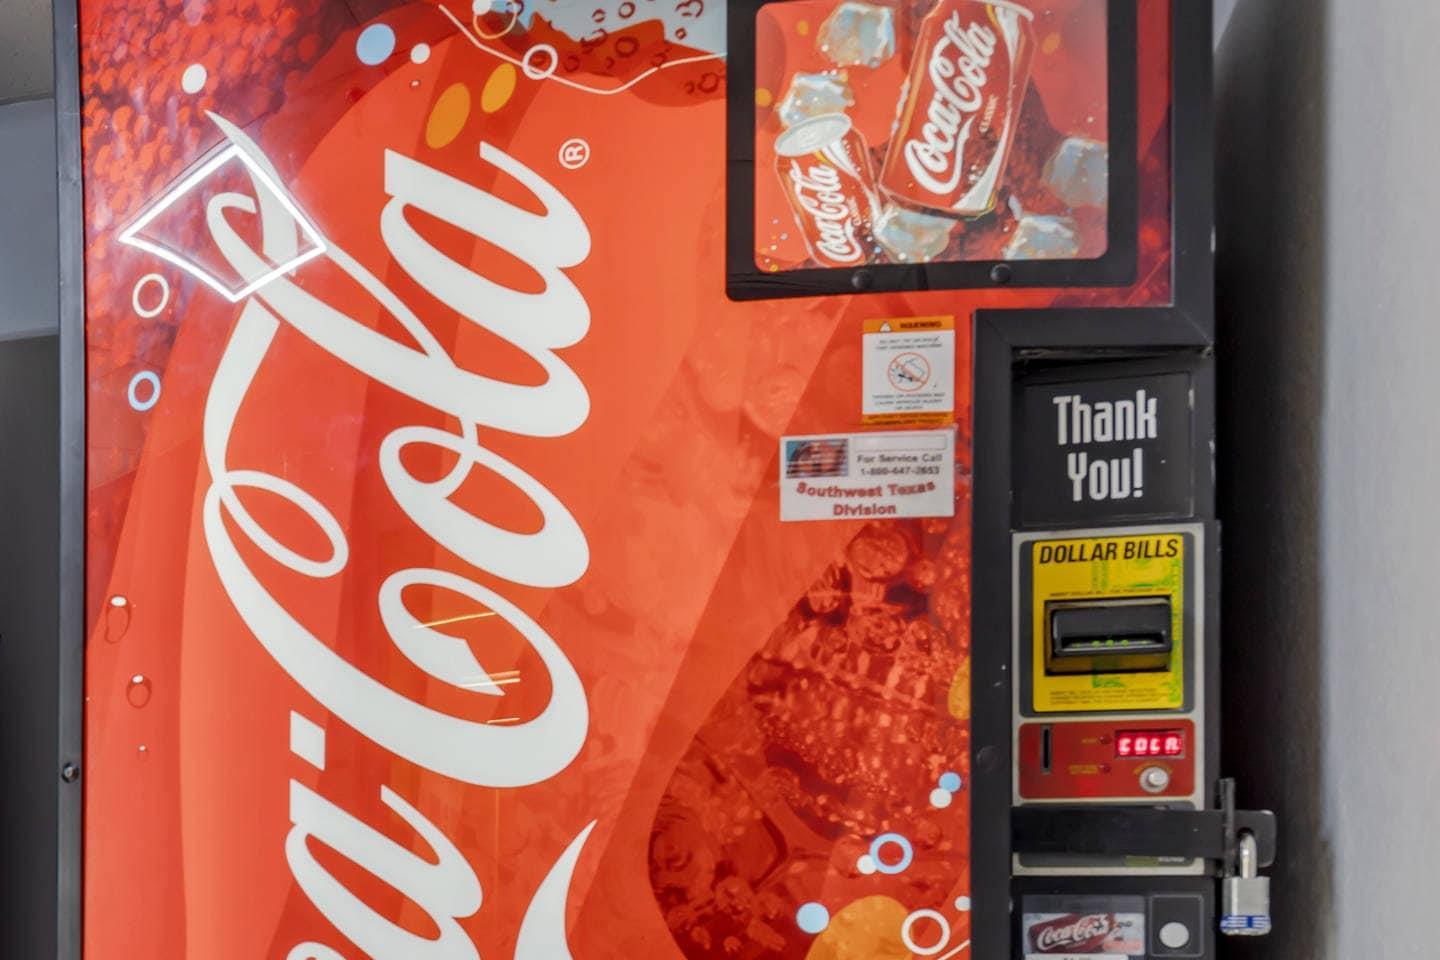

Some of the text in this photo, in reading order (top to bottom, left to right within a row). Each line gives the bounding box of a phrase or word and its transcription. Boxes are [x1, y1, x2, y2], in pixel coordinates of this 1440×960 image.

[1052, 389, 1158, 445] Thank
[857, 453, 942, 463] For Service Call
[1066, 448, 1144, 501] You!
[796, 481, 936, 497] Southwest Texas
[833, 503, 897, 517] Division
[1039, 539, 1178, 564] DOLLAR BILLS
